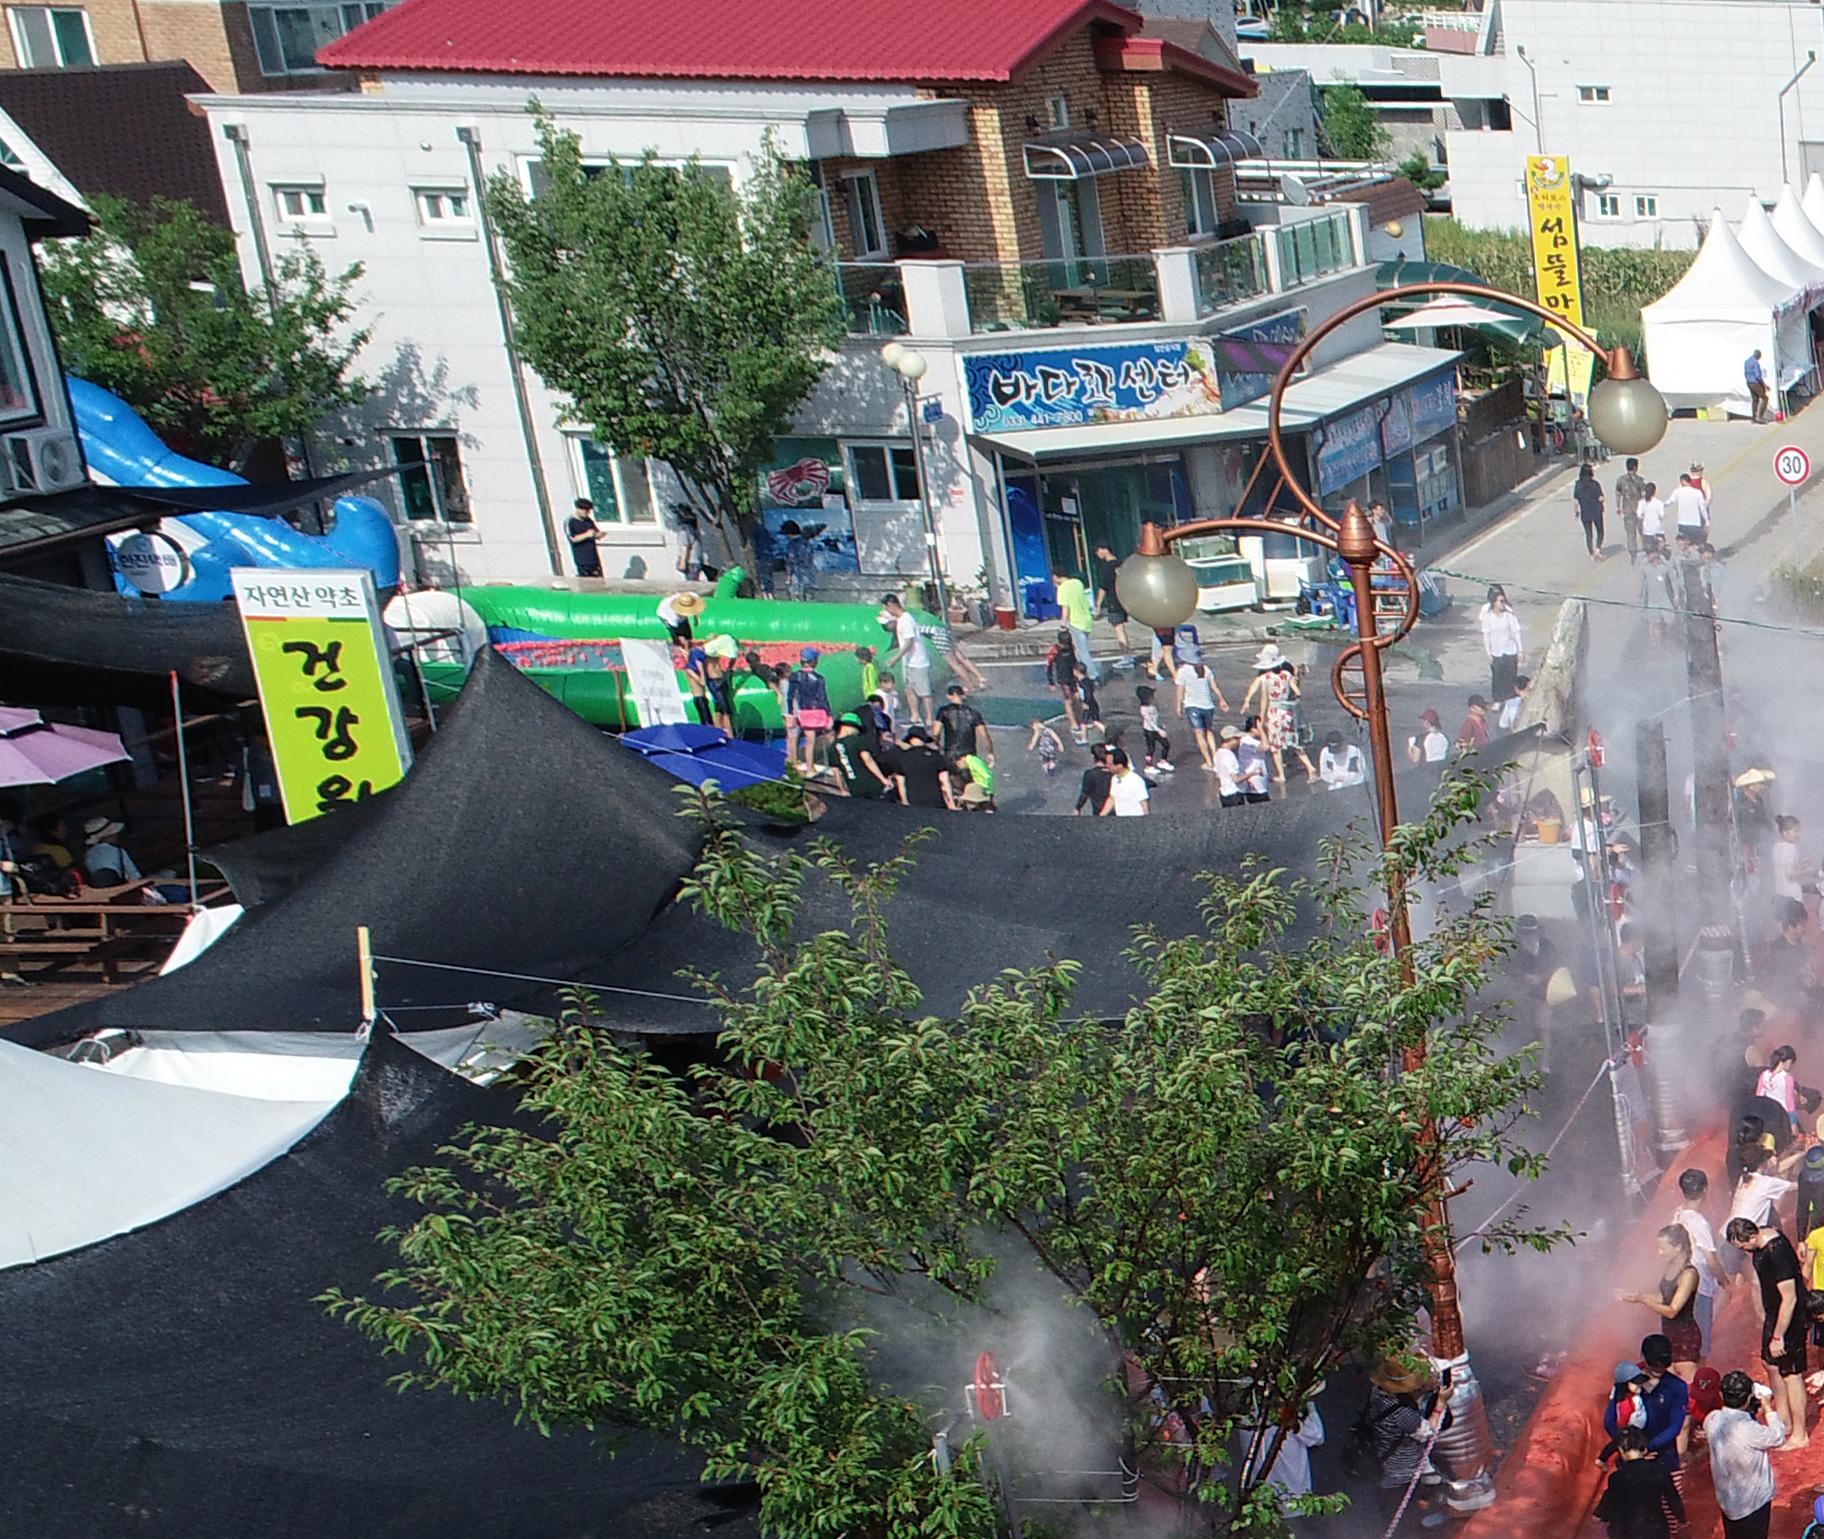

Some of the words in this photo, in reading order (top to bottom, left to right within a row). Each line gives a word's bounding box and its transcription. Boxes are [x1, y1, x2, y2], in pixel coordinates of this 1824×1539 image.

[1540, 217, 1575, 321] 섬뜰마
[1782, 455, 1802, 475] 30
[244, 586, 310, 608] 자연산
[315, 586, 362, 609] 약초
